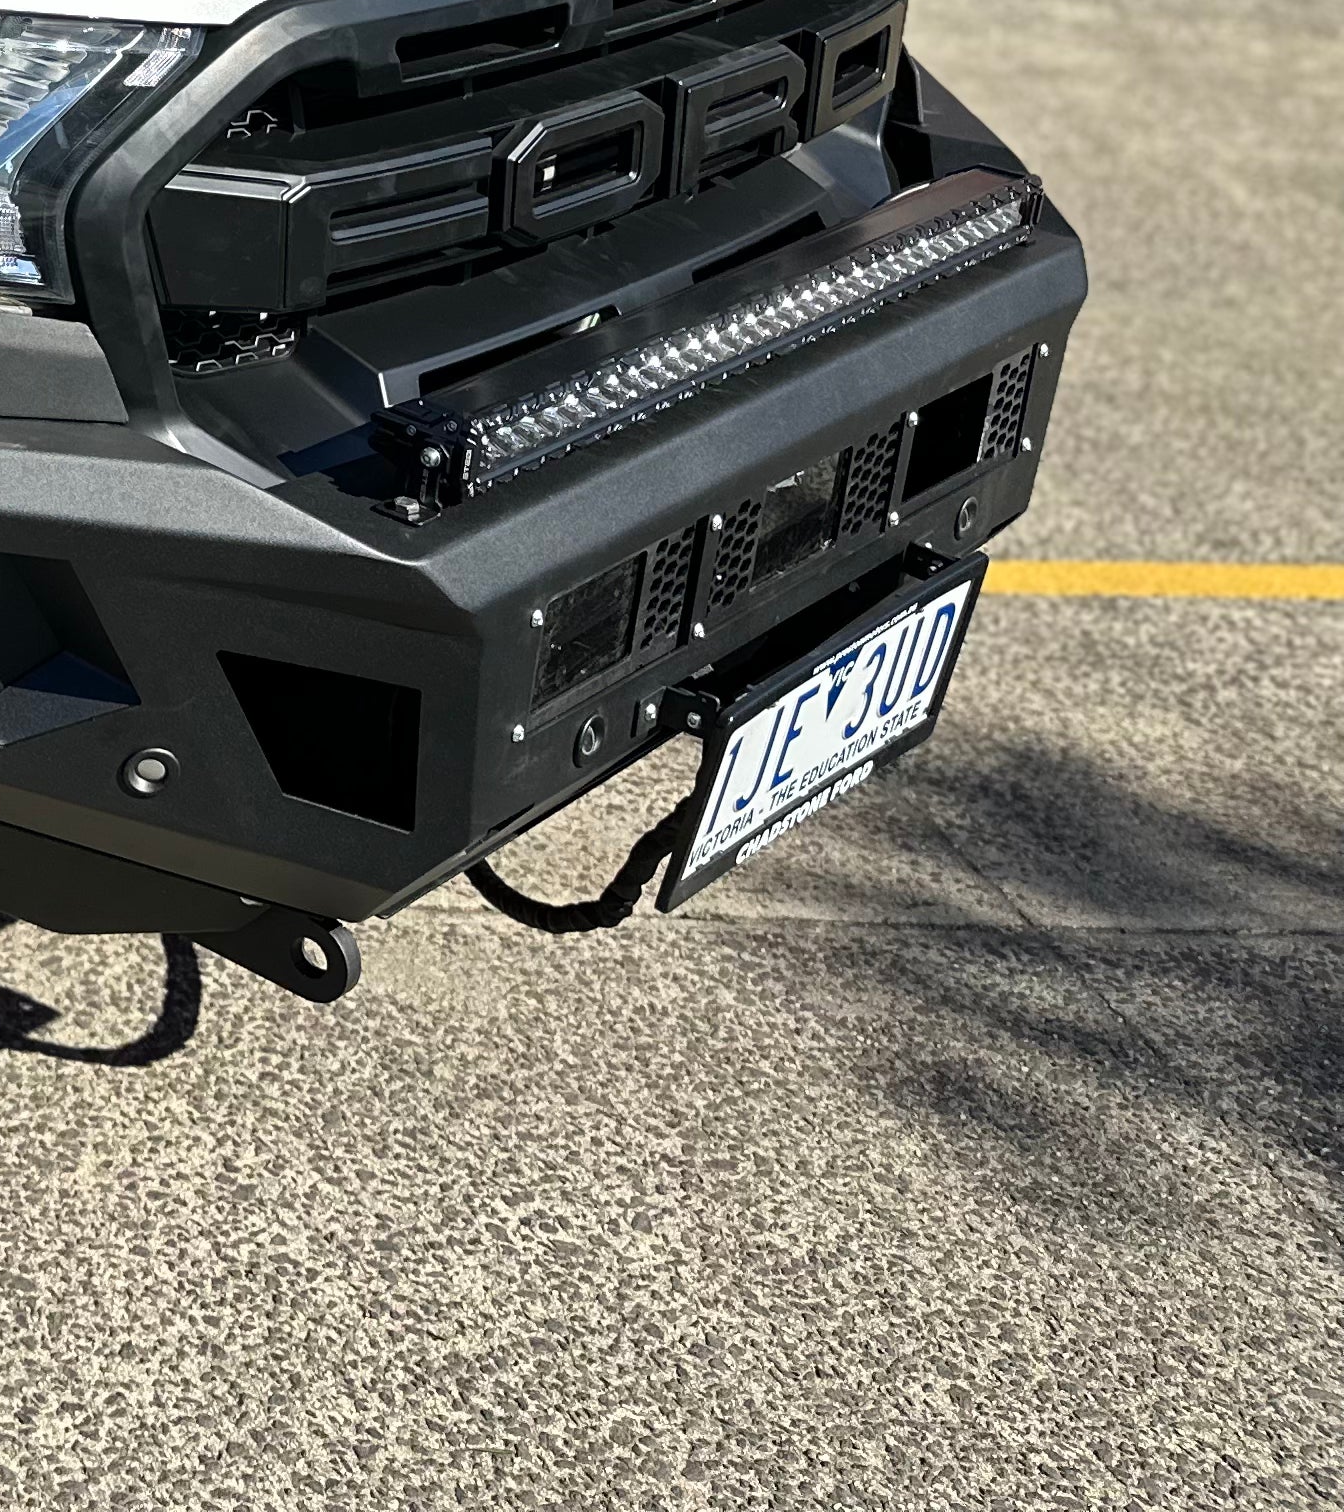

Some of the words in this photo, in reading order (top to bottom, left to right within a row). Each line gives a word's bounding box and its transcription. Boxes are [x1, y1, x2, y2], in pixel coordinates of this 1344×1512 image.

[688, 807, 754, 868] VICTORIA
[770, 778, 799, 812] THE
[798, 727, 879, 791] EDUCATION
[879, 700, 922, 739] STATE
[708, 682, 821, 835] 1JE
[841, 602, 956, 740] 3UD
[735, 786, 832, 865] CHADSTONE
[829, 759, 874, 801] FORD
